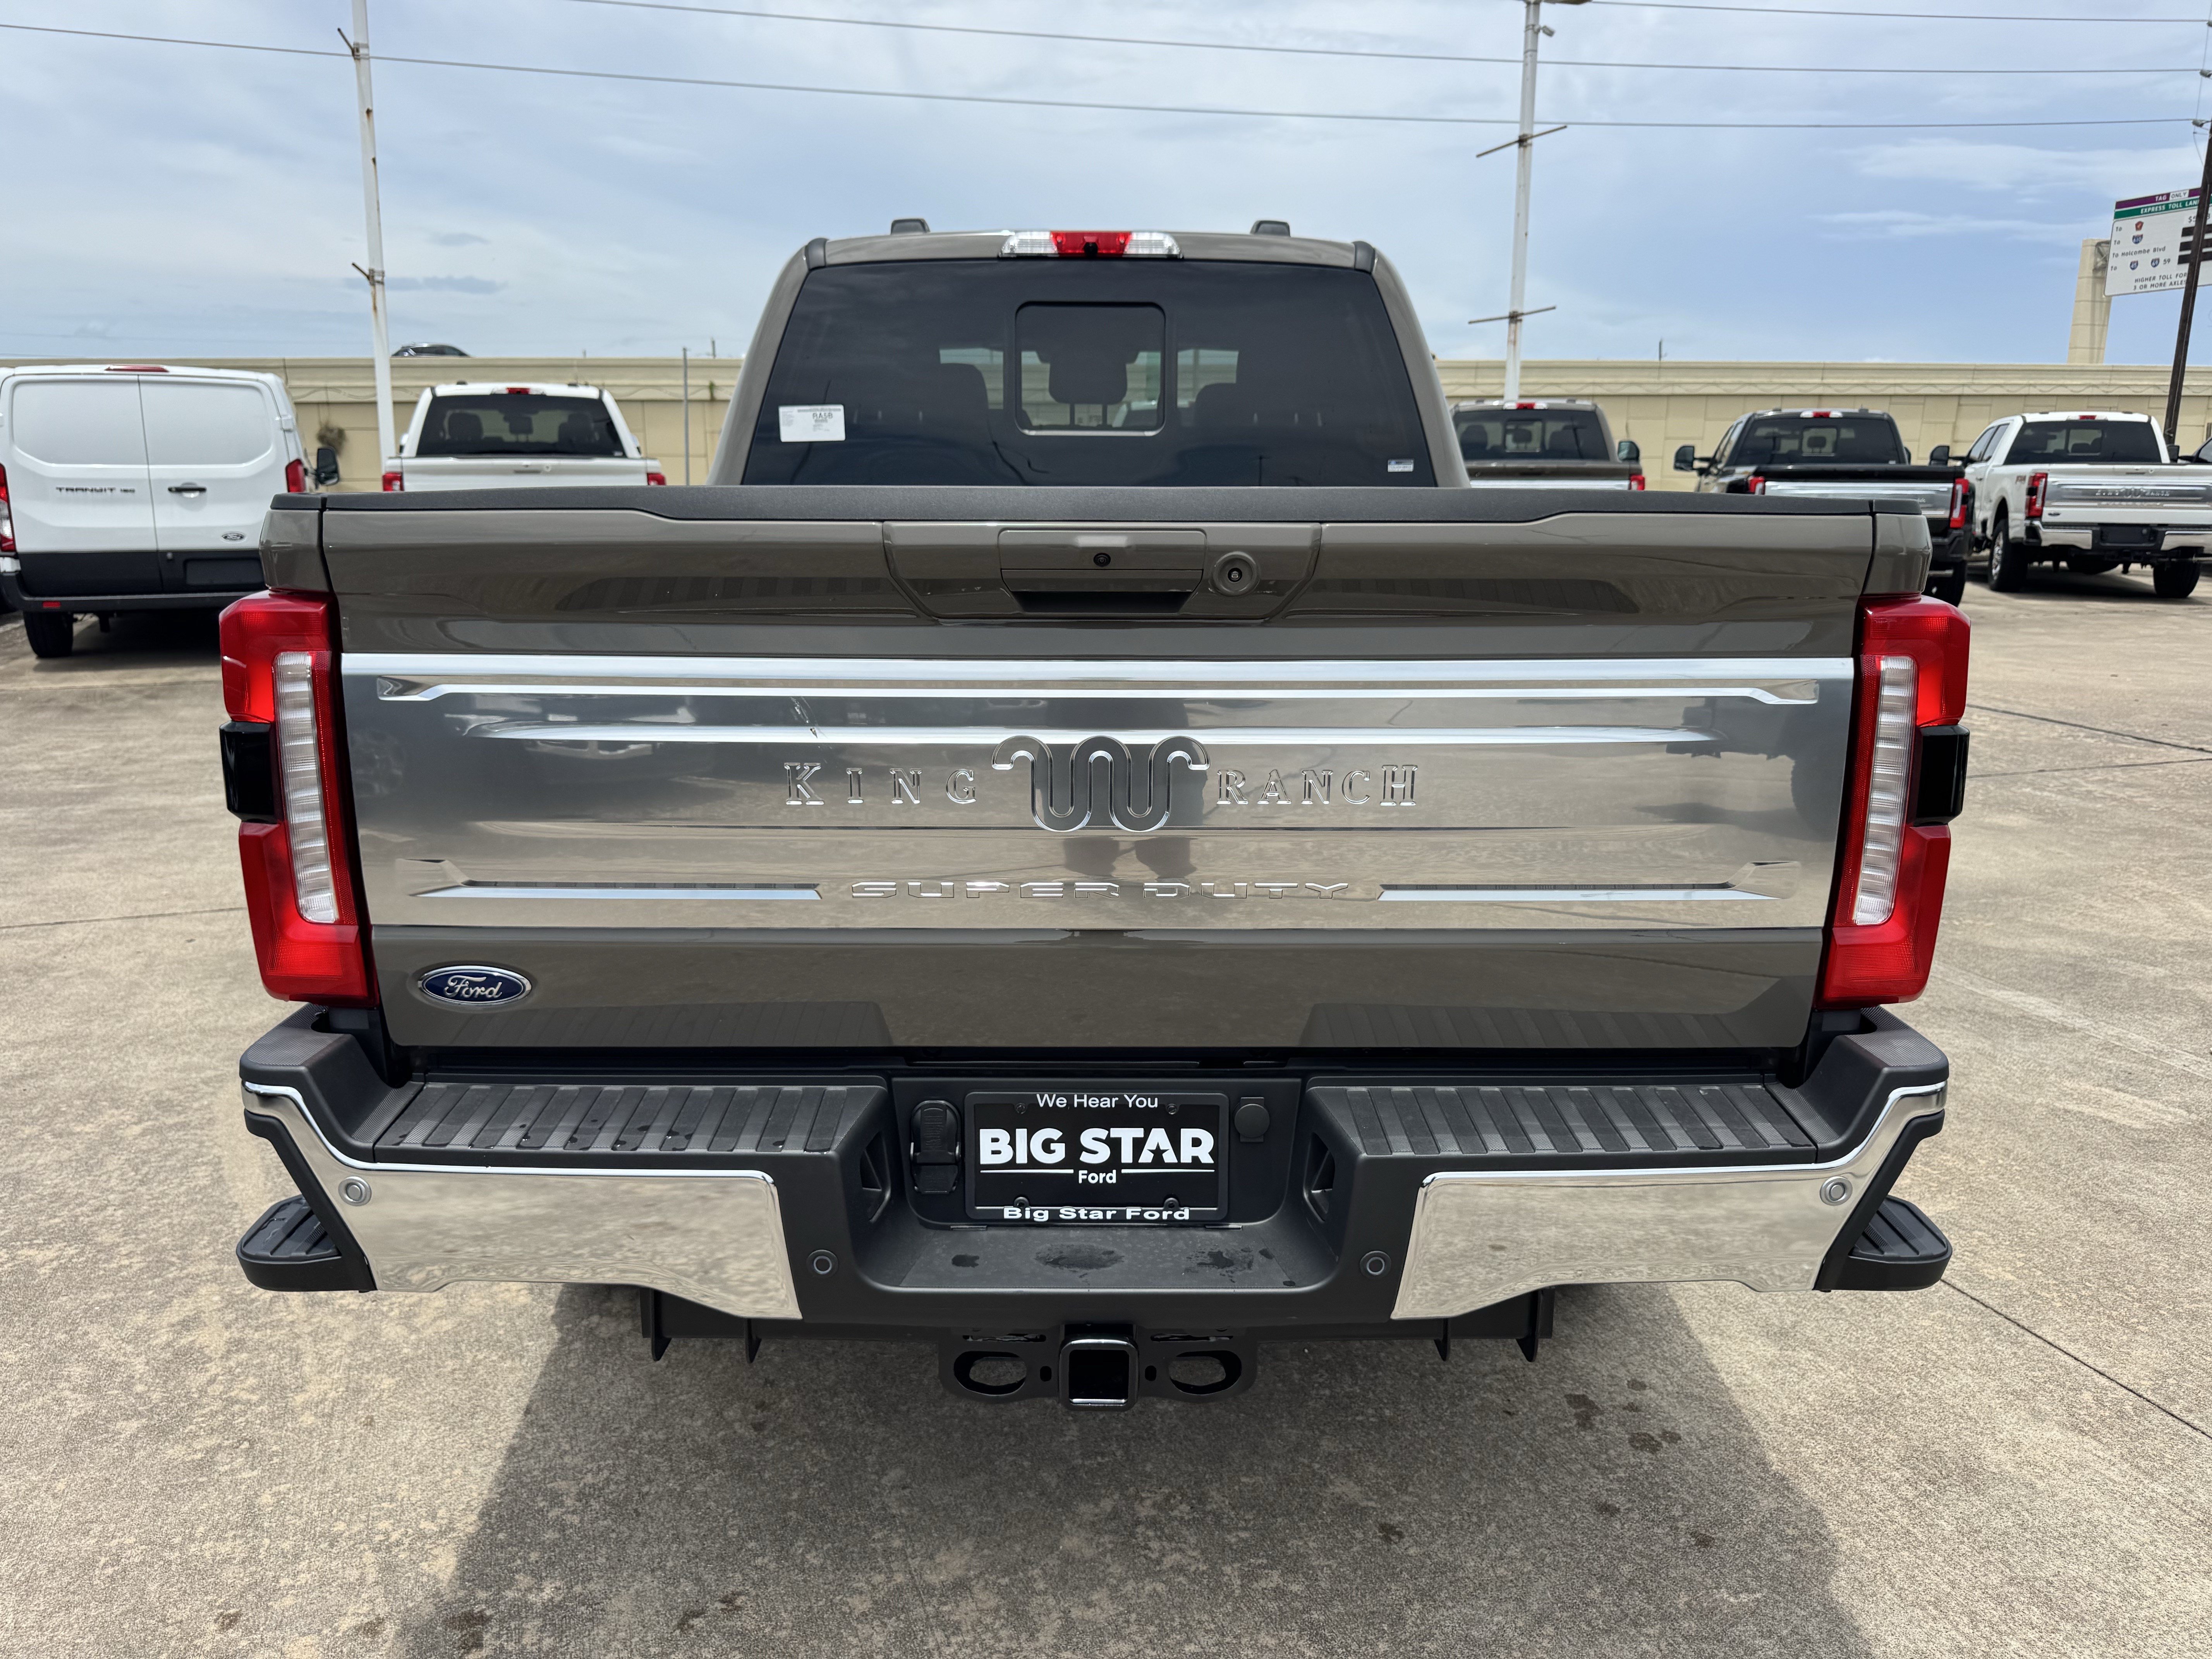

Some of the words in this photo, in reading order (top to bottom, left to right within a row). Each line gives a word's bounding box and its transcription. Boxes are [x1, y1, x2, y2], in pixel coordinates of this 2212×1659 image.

[2140, 204, 2166, 214] EXPRESS
[2121, 248, 2150, 257] Holcombe
[784, 762, 976, 805] KING
[1216, 764, 1419, 807] RANCH
[852, 881, 1120, 898] SUPER
[1143, 882, 1349, 899] DUTY
[444, 975, 503, 998] Ford
[1036, 1094, 1067, 1108] We
[1073, 1094, 1119, 1108] Hear
[1123, 1094, 1158, 1109] You
[979, 1128, 1065, 1165] BIG
[1079, 1127, 1214, 1164] STAR
[1078, 1170, 1116, 1184] Ford
[1003, 1207, 1049, 1221] Big
[1059, 1207, 1117, 1220] Star
[1126, 1208, 1190, 1220] Ford
